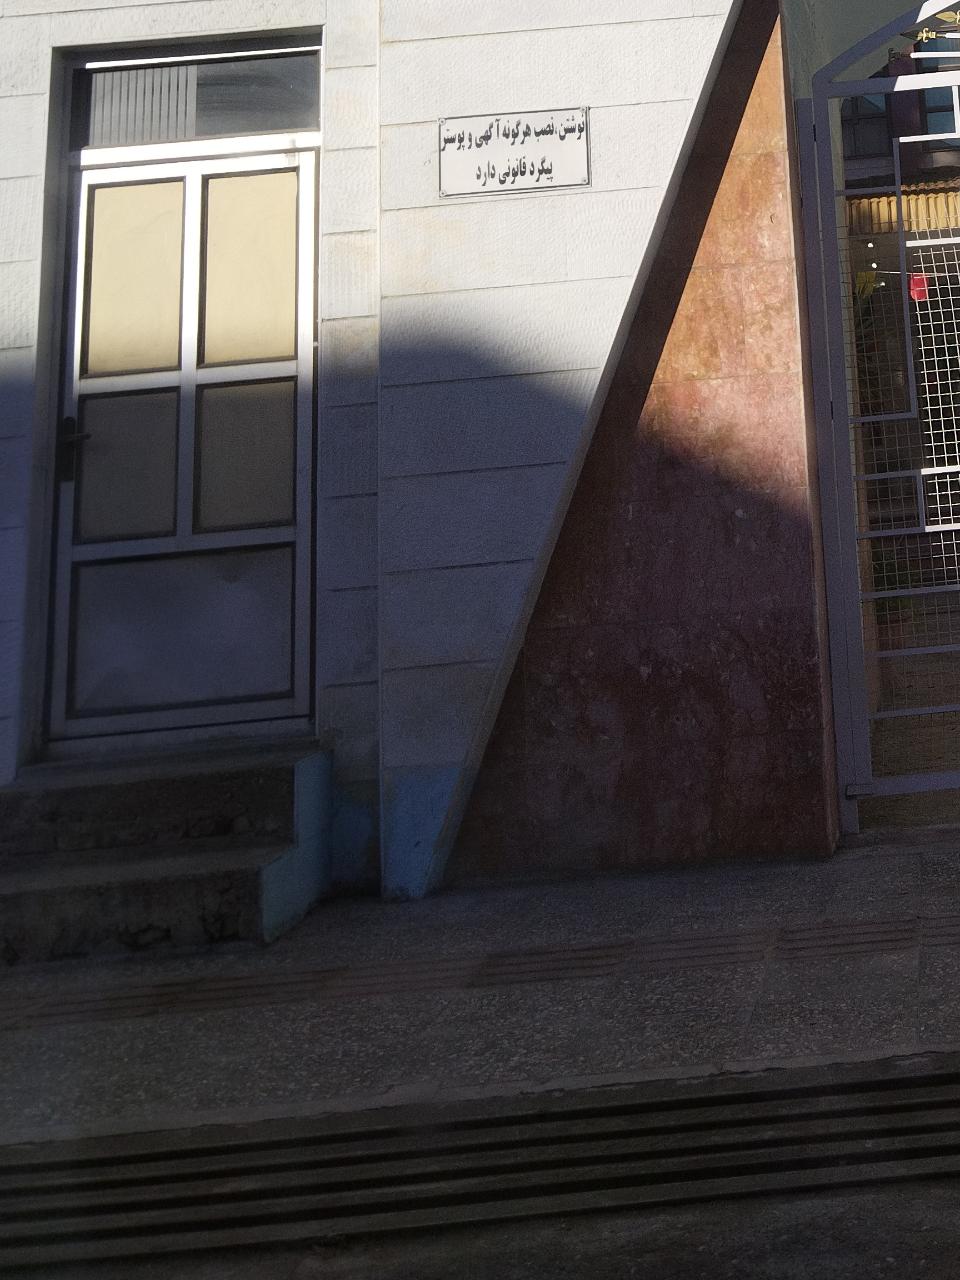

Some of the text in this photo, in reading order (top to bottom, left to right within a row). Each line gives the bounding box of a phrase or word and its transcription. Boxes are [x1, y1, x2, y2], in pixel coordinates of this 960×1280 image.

[441, 129, 465, 152] پوستر
[467, 131, 473, 149] و
[533, 116, 555, 143] نصب
[476, 161, 496, 187] دارد
[498, 156, 527, 185] قانونی
